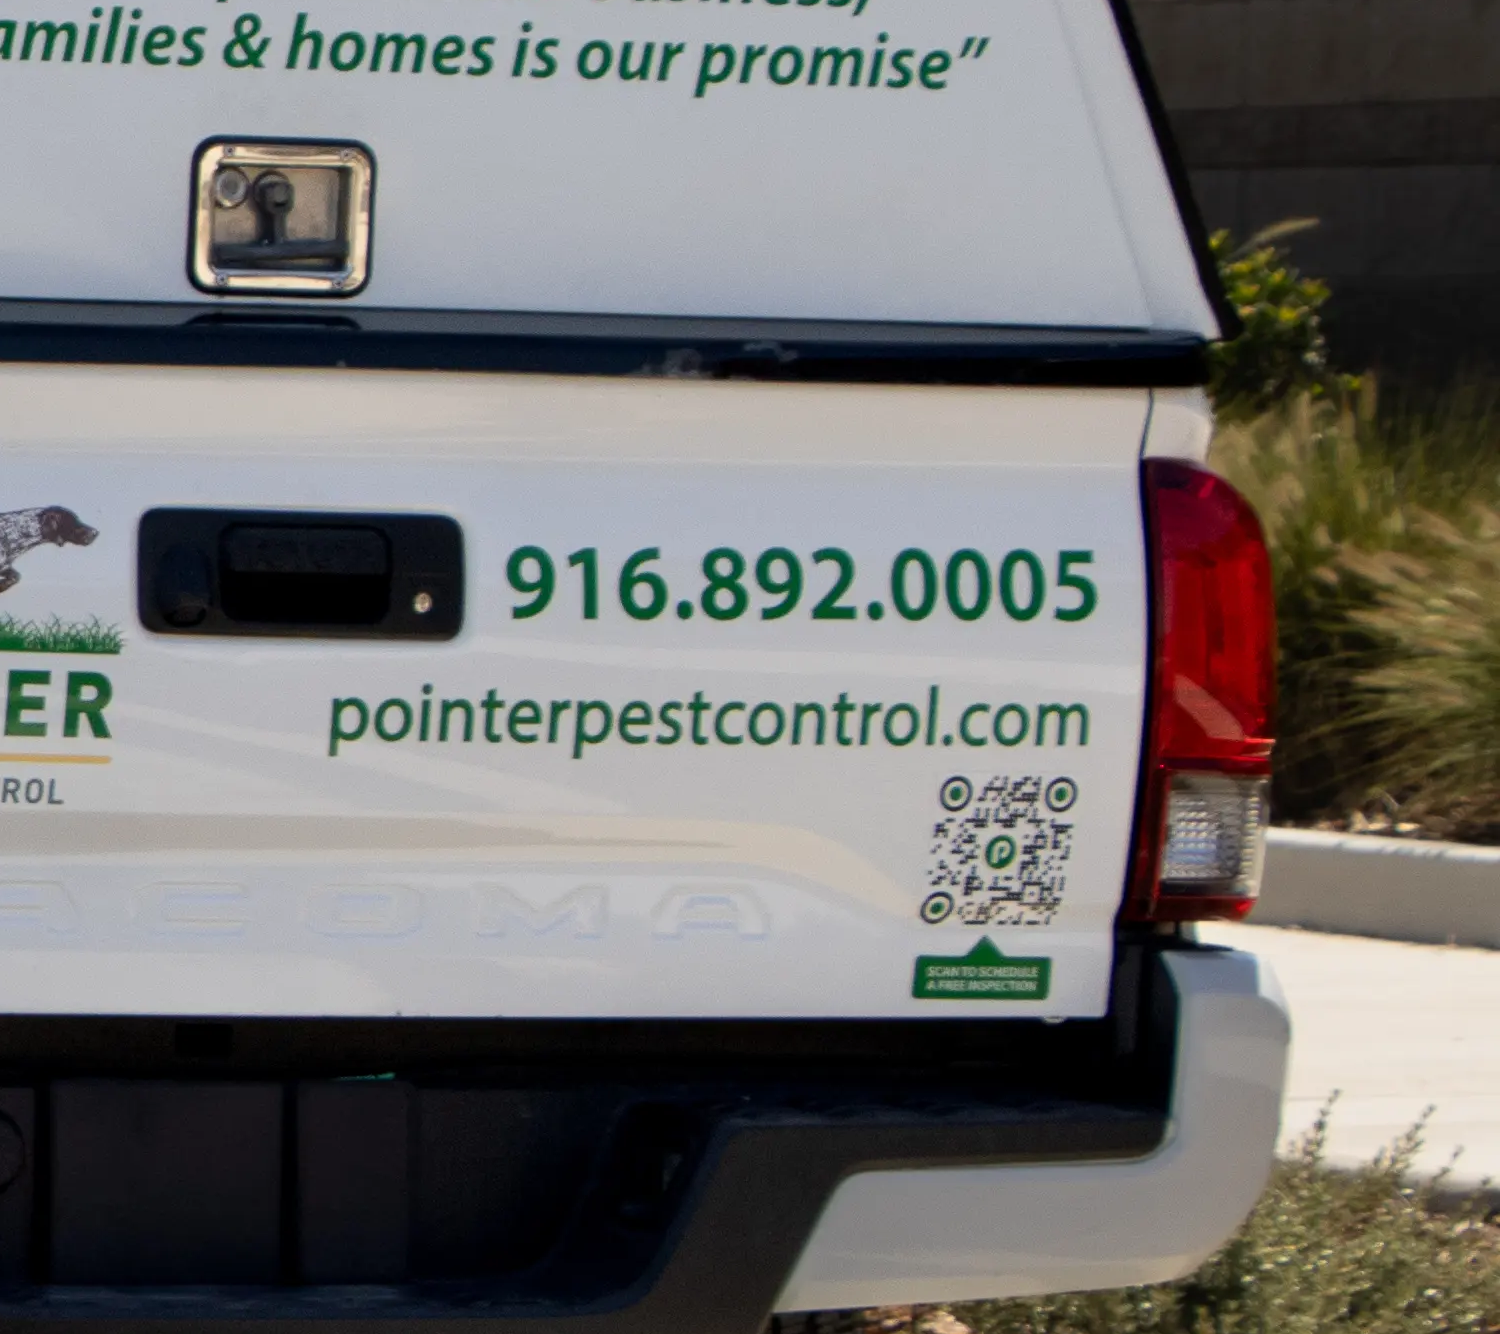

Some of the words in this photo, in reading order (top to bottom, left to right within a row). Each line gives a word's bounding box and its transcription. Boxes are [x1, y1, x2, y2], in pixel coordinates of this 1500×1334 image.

[223, 13, 272, 69] &
[286, 12, 496, 77] homes
[512, 22, 560, 79] is
[577, 40, 685, 82] our
[695, 32, 989, 99] promise”
[505, 545, 1099, 623] 916.892.0005
[328, 683, 1090, 760] pointerpestcontrol.com
